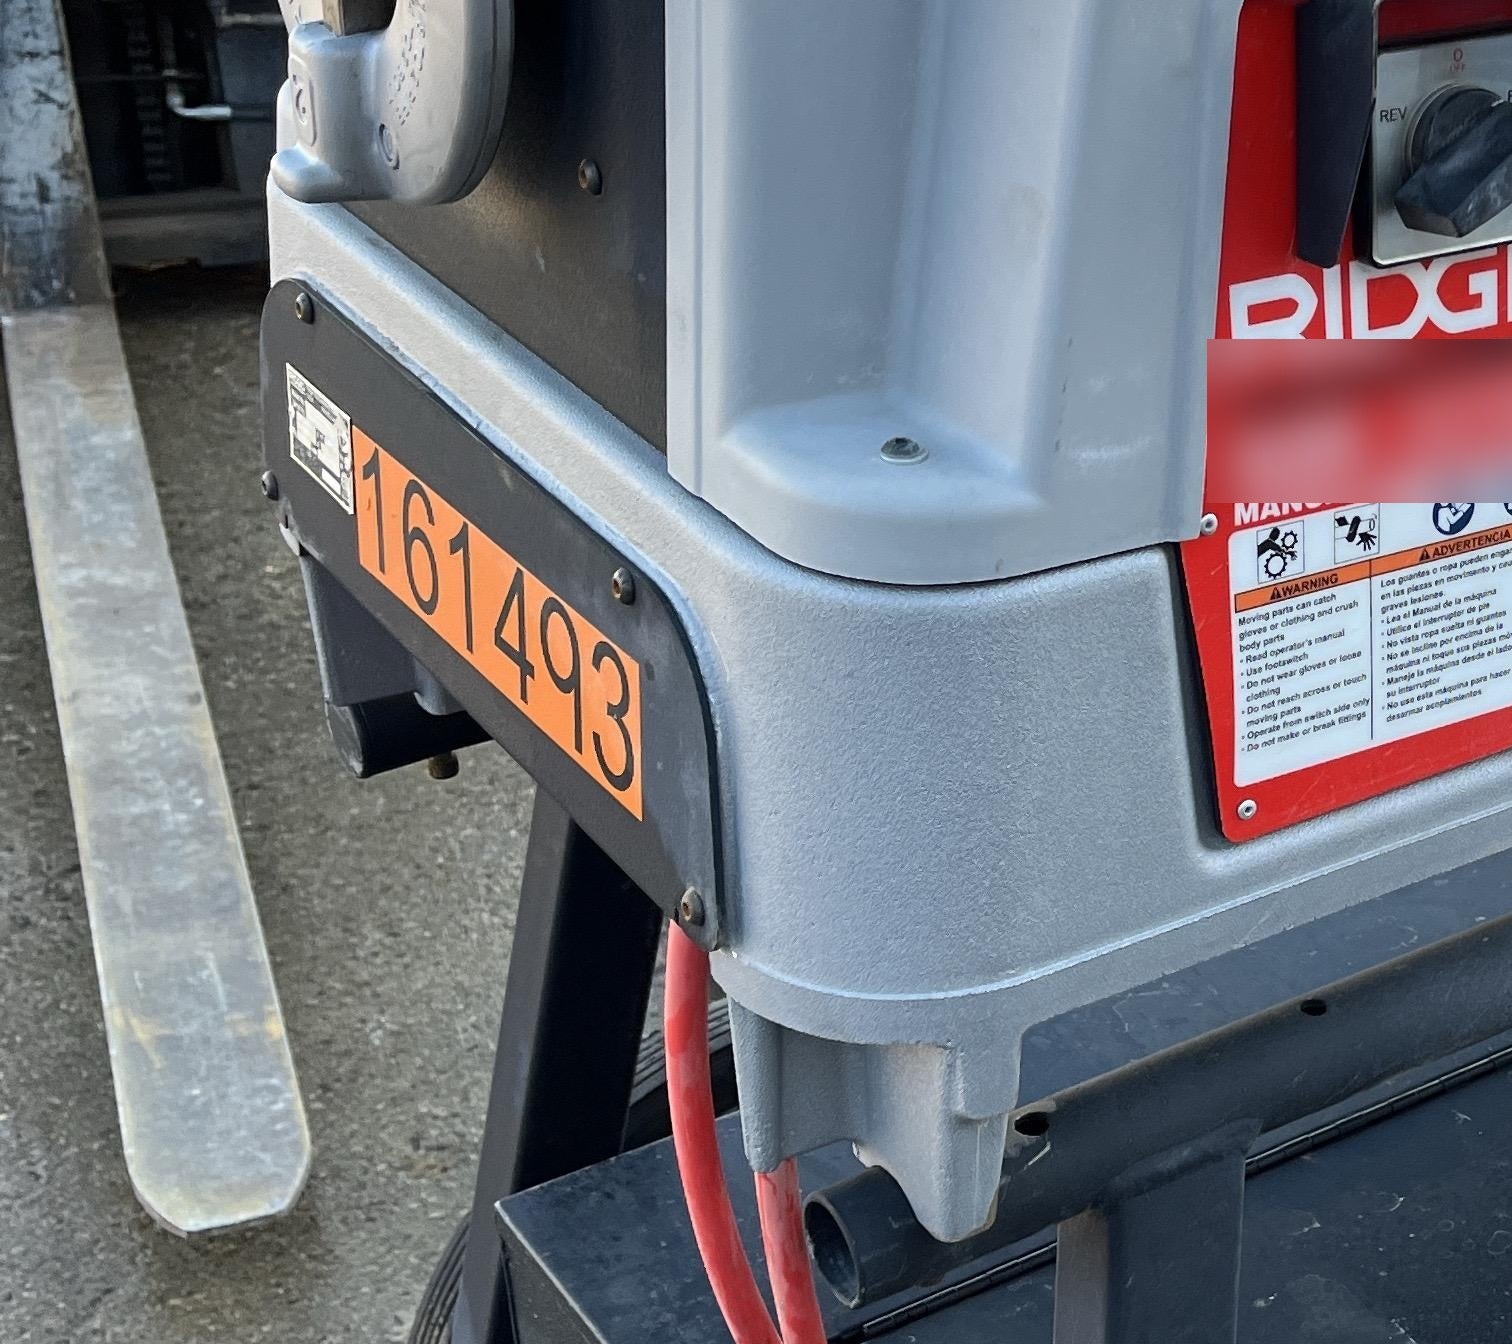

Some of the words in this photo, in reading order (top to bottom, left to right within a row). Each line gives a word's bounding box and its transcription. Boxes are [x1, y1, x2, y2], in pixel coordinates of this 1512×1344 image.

[1379, 107, 1407, 123] REV
[1433, 529, 1511, 557] ADVERTENCIA
[1381, 578, 1395, 588] Los
[1398, 569, 1430, 585] guantes
[1440, 563, 1457, 575] ropa
[1460, 554, 1489, 568] pueden
[1282, 574, 1338, 597] WARNING
[1381, 591, 1390, 600] en
[1393, 587, 1404, 596] las
[1407, 580, 1432, 594] piezas
[1435, 578, 1444, 586] en
[362, 447, 634, 792] 161493
[1238, 613, 1270, 626] Moving
[1272, 607, 1294, 616] parts
[1296, 602, 1311, 610] can
[1314, 594, 1336, 607] catch
[1239, 626, 1267, 640] gloves
[1281, 613, 1315, 627] clothing
[1318, 607, 1332, 617] and
[1335, 601, 1359, 613] crush
[1381, 599, 1407, 614] graves
[1386, 615, 1401, 624] Lea
[1403, 611, 1410, 619] el
[1413, 603, 1441, 617] Manual
[1455, 596, 1462, 605] la
[1467, 606, 1476, 615] de
[1239, 640, 1260, 653] body
[1263, 634, 1284, 647] parts
[1246, 650, 1268, 663] Read
[1270, 640, 1312, 656] operator's
[1315, 629, 1345, 644] manual
[1387, 640, 1398, 649] No
[1400, 635, 1419, 645] vista
[1421, 629, 1439, 642] ropa
[1387, 651, 1398, 661] No
[1440, 637, 1453, 648] por
[1455, 628, 1483, 642] encima
[1472, 637, 1496, 650] piezas
[1246, 666, 1262, 676] Use
[1265, 653, 1308, 671] footswitch
[1246, 681, 1259, 689] Do
[1261, 675, 1274, 685] not
[1277, 670, 1297, 681] wear
[1299, 662, 1326, 675] gloves
[1339, 650, 1361, 661] loose
[1246, 687, 1281, 702] clothing
[1247, 705, 1259, 714] Do
[1261, 701, 1275, 710] not
[1277, 693, 1300, 705] reach
[1303, 685, 1330, 698] across
[1333, 681, 1341, 689] or
[1343, 674, 1367, 686] touch
[1387, 702, 1398, 710] No
[1470, 674, 1487, 688] para
[1247, 714, 1278, 727] moving
[1280, 707, 1302, 718] parts
[1247, 726, 1280, 739] Operate
[1283, 719, 1302, 729] from
[1304, 710, 1332, 723] switch
[1334, 704, 1351, 714] side
[1353, 697, 1370, 710] only
[1247, 744, 1259, 752] Do
[1261, 738, 1275, 748] not
[1278, 731, 1300, 742] make
[1302, 727, 1311, 735] or
[1313, 721, 1336, 732] break
[1338, 711, 1366, 725] fittings
